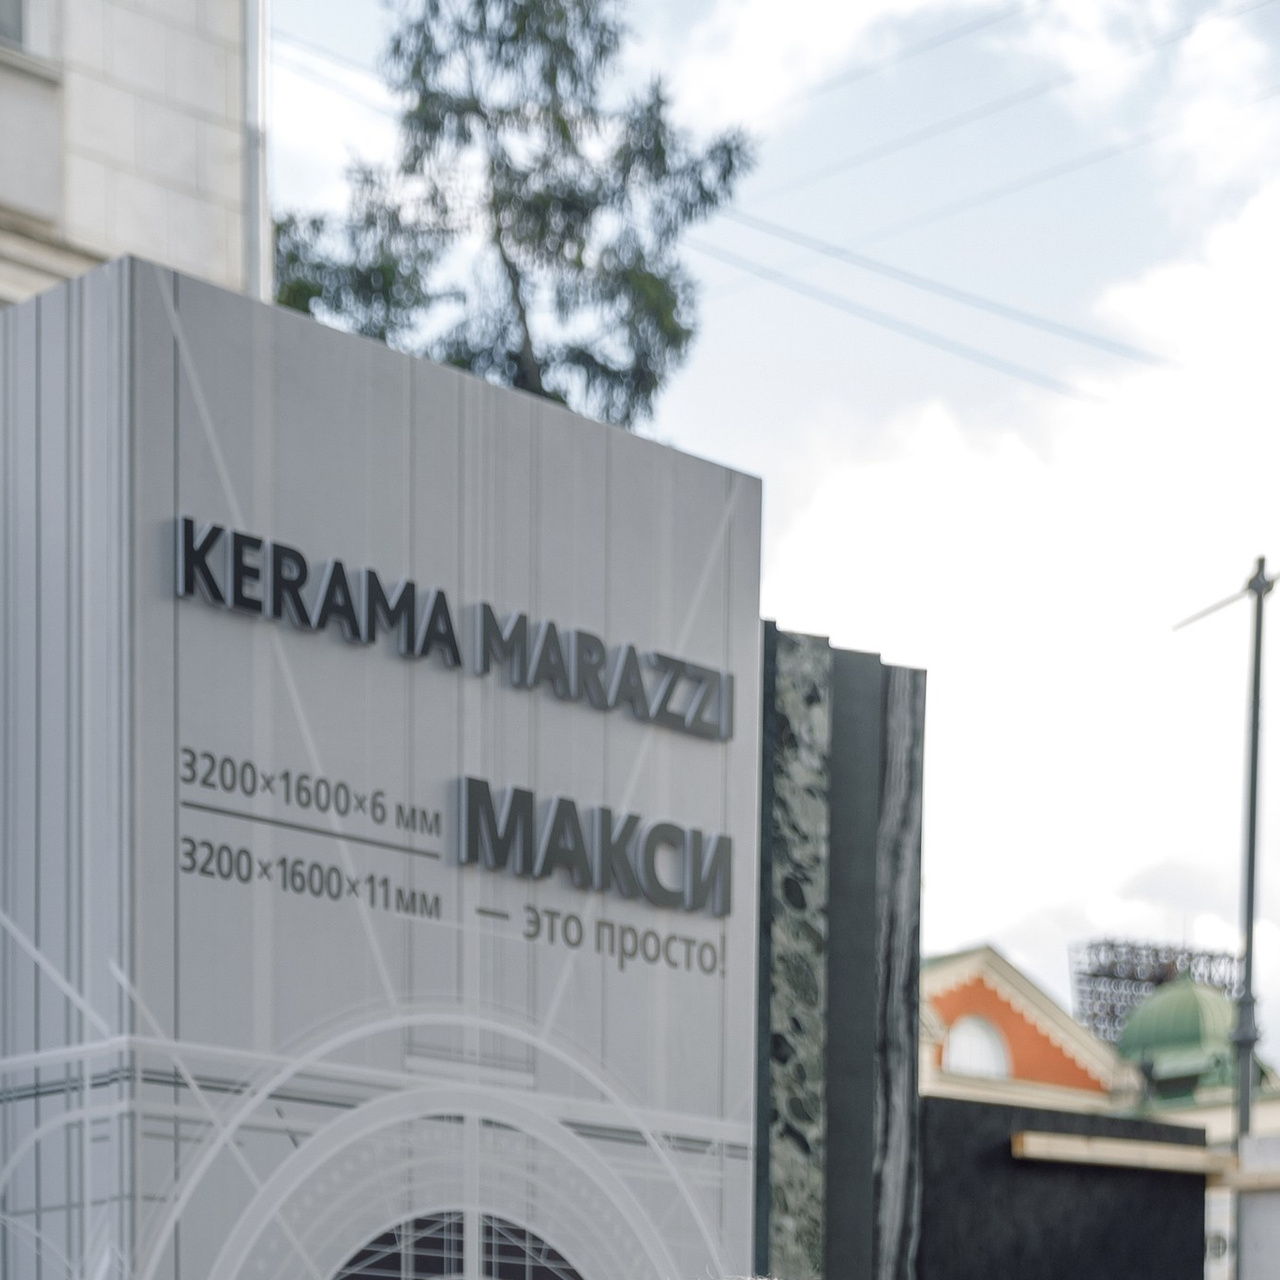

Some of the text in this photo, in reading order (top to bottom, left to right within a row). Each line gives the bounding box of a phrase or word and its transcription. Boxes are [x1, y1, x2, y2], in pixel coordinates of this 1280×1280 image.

[177, 516, 734, 742] KERAMA MARAZZI
[458, 776, 732, 919] МАКСИ
[521, 905, 584, 950] это
[594, 919, 726, 979] просто!
